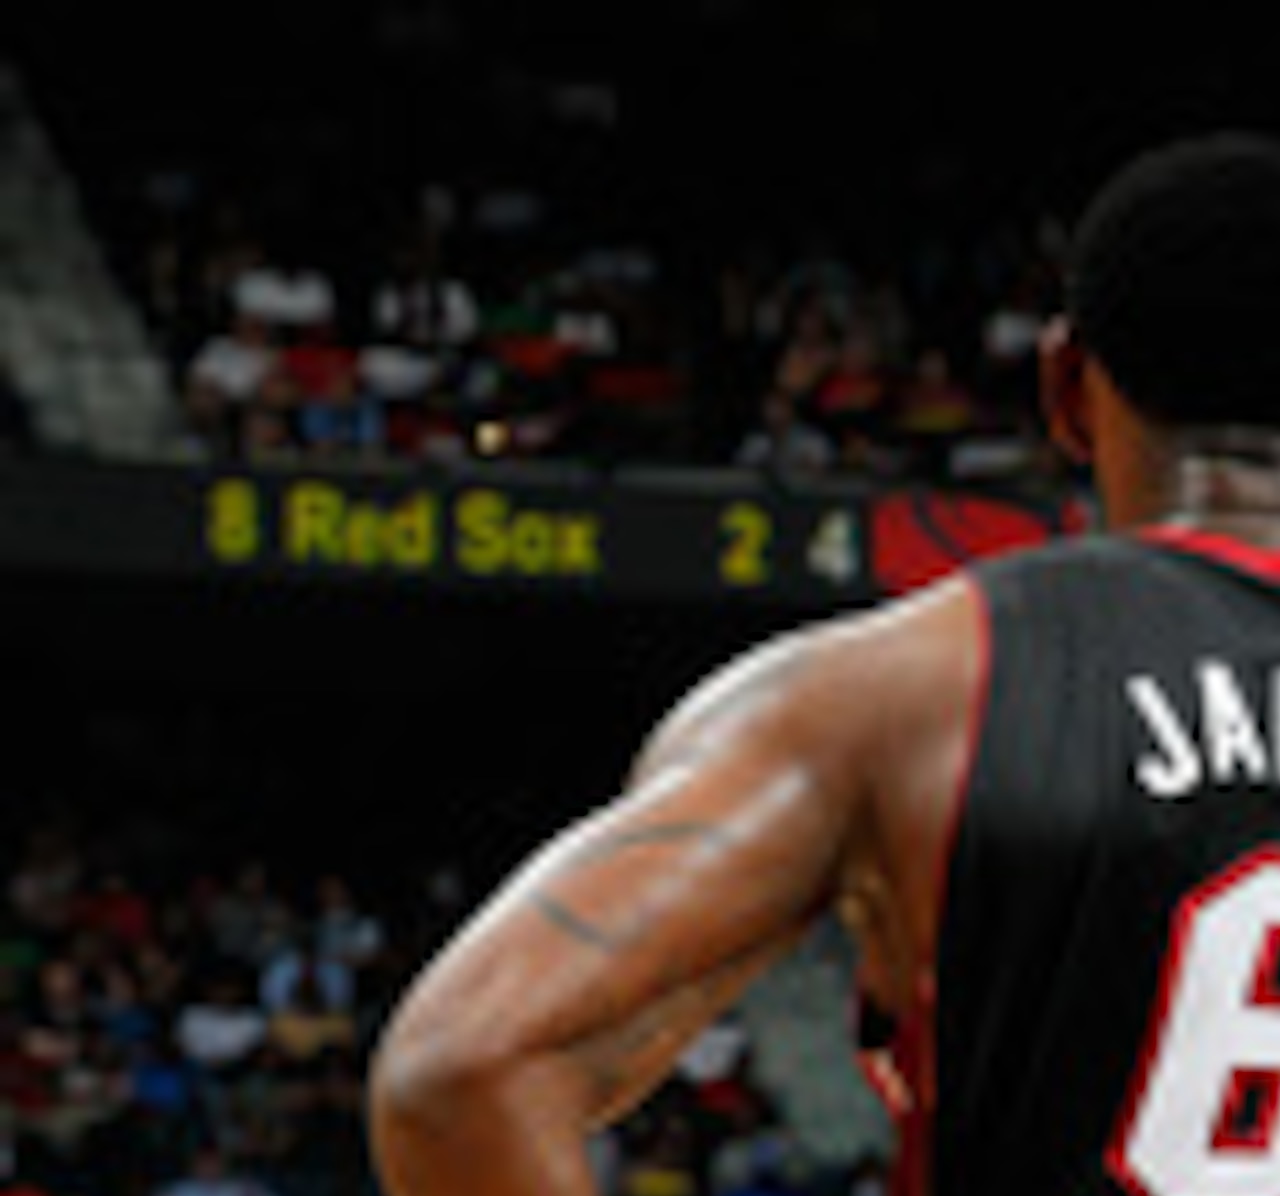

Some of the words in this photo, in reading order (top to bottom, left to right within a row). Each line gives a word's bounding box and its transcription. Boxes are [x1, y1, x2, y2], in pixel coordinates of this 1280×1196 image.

[208, 481, 258, 558] 8
[284, 481, 436, 567] Red
[454, 490, 598, 576] Sox
[717, 507, 772, 583] 2
[807, 510, 858, 579] 4
